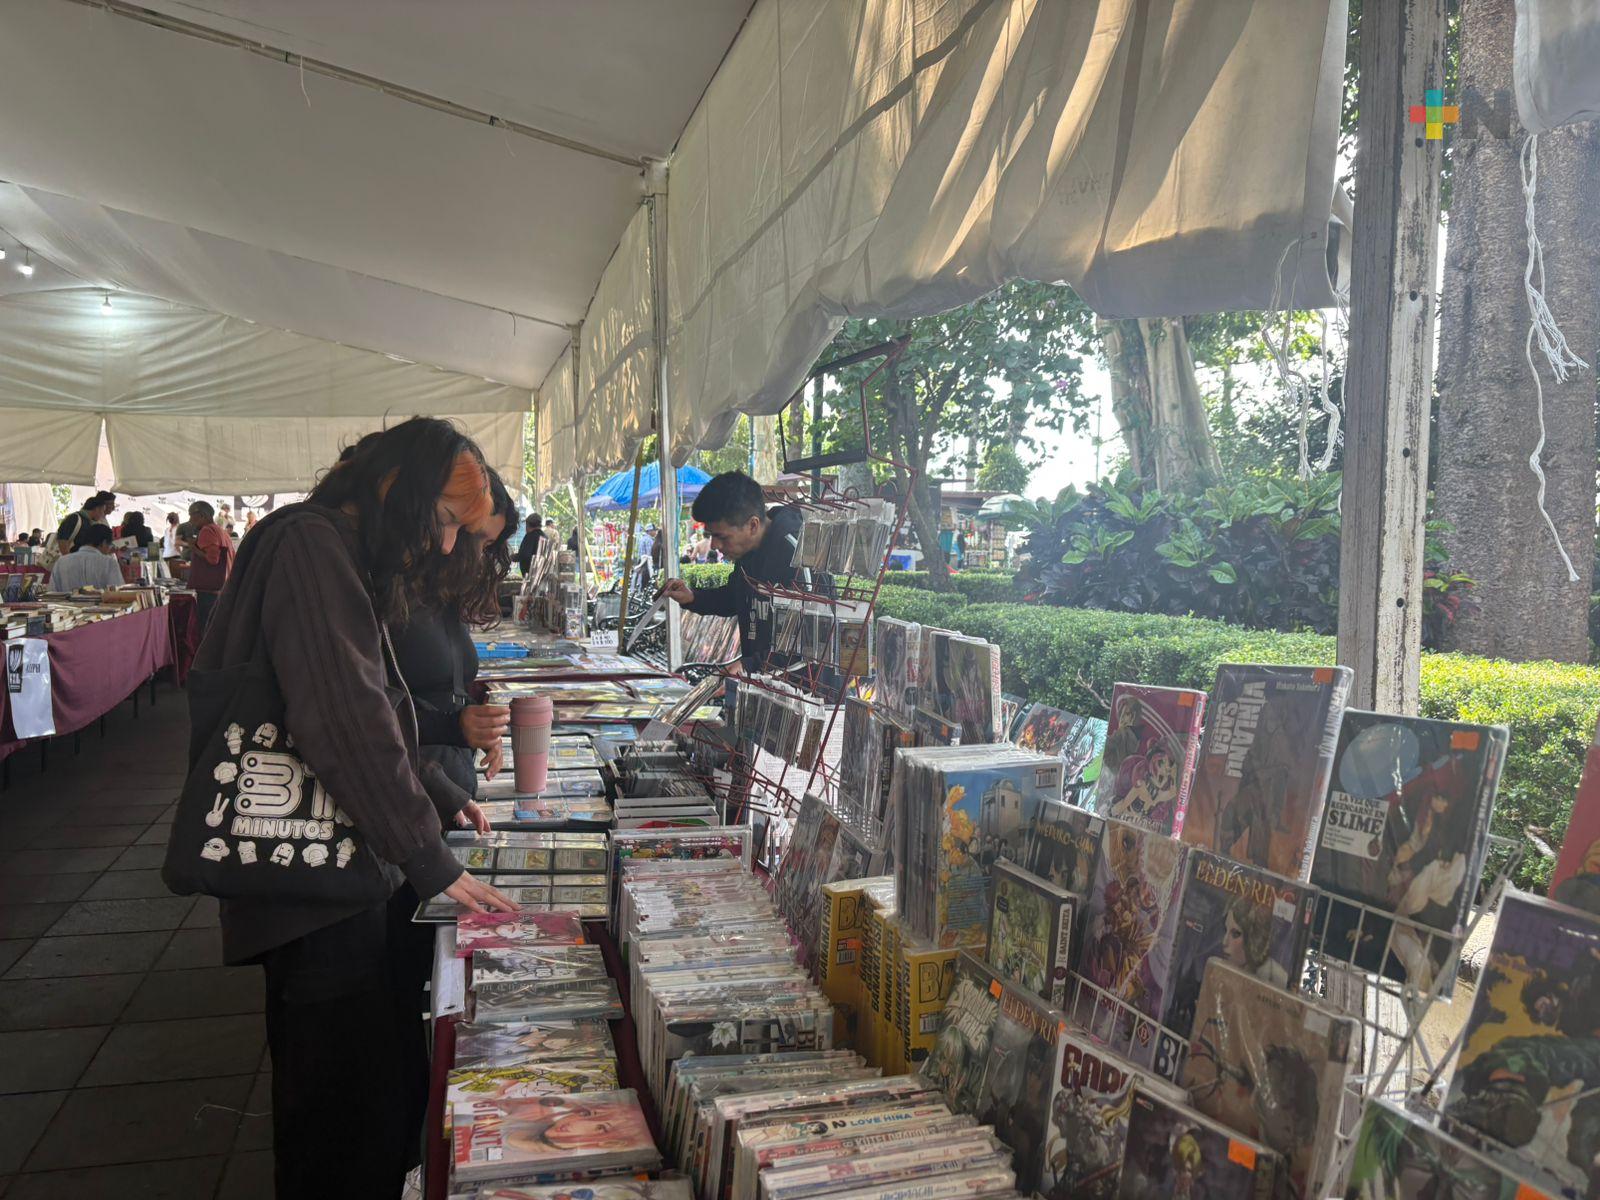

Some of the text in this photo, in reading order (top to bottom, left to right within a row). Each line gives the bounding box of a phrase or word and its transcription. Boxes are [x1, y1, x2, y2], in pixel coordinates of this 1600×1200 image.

[1339, 793, 1350, 802] LA
[1365, 799, 1381, 809] QUE
[1328, 809, 1384, 835] SLIME
[1374, 810, 1386, 819] EN
[231, 816, 334, 840] MINUTOS
[1196, 861, 1250, 897] ELDEN
[820, 925, 831, 980] BANANA
[1002, 992, 1039, 1033] ELDEN
[1039, 1018, 1058, 1047] RIN
[473, 1101, 502, 1147] GIGANT
[850, 1116, 881, 1126] LOVE
[883, 1113, 912, 1122] HINA
